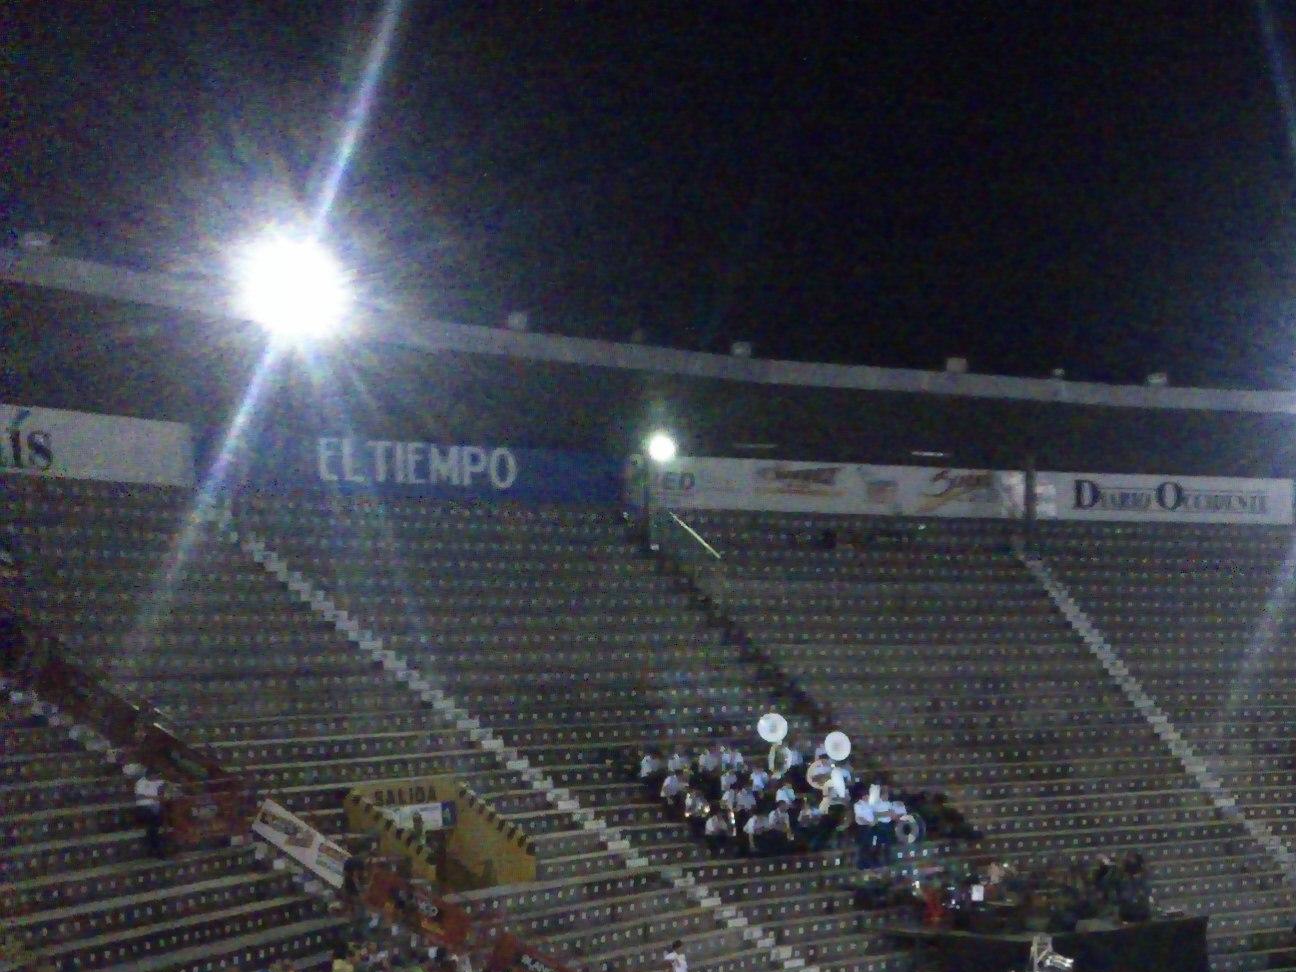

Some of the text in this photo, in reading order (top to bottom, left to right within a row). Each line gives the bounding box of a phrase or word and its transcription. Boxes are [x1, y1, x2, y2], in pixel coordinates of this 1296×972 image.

[0, 409, 53, 473] ís
[319, 437, 519, 489] EL TIEMPO
[374, 786, 437, 803] SALIDA
